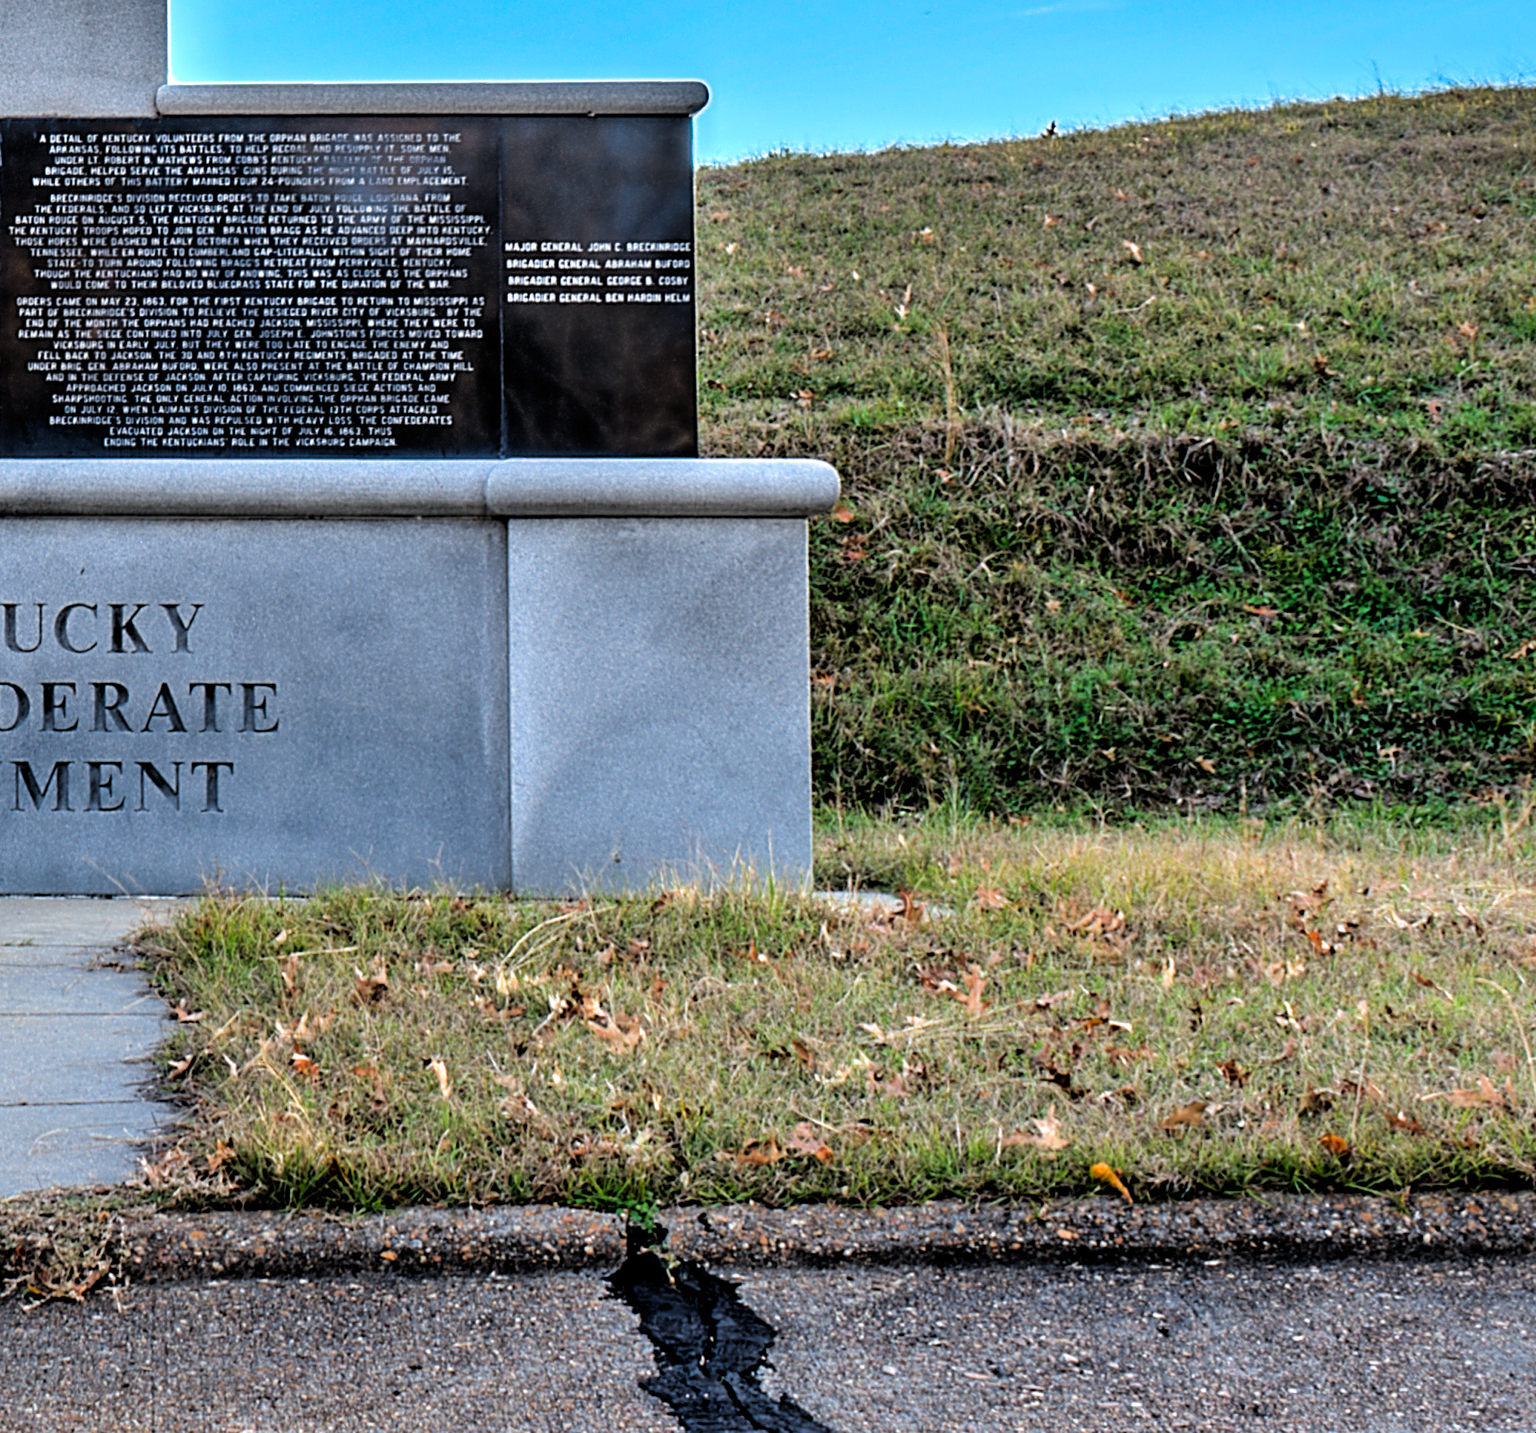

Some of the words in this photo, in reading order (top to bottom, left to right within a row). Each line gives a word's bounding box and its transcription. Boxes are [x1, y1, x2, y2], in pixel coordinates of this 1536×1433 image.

[39, 134, 47, 144] A
[49, 134, 83, 144] DETAIL
[86, 134, 99, 144] OF
[102, 134, 151, 144] KENTUCKY
[155, 134, 215, 144] VOLUNTEERS
[218, 134, 245, 144] FROM
[247, 134, 266, 144] THE
[269, 134, 307, 144] ORPHAN
[309, 134, 349, 144] BRIGADE
[353, 134, 373, 144] WAS
[377, 134, 423, 144] ASSIGNED
[426, 134, 439, 144] TO
[442, 134, 462, 144] THE
[504, 243, 538, 252] MAJOR
[540, 243, 584, 252] GENERAL
[587, 243, 612, 252] JOHN
[626, 243, 691, 252] BRECKINRIDGE
[506, 259, 556, 269] BRIGADIER
[558, 259, 602, 269] GENERAL
[604, 259, 652, 269] ABRAHAM
[654, 259, 691, 269] BUFORD
[507, 276, 558, 286] BRIGADIER
[559, 276, 604, 286] GENERAL
[606, 276, 643, 286] GEORGE
[658, 276, 689, 286] COSBY
[16, 297, 52, 306] ORDERS
[56, 297, 81, 306] CAME
[85, 297, 98, 306] ON
[100, 297, 121, 306] MAY
[170, 297, 189, 306] FOR
[192, 297, 210, 306] THE
[214, 297, 241, 306] FIRST
[244, 297, 293, 306] KENTUCKY
[296, 297, 336, 306] BRIGADE
[341, 297, 354, 306] TO
[356, 297, 394, 306] RETURN
[397, 297, 410, 306] TO
[413, 297, 468, 306] MISSISSIPPI
[472, 297, 485, 306] AS
[507, 293, 556, 303] BRIGADIER
[558, 293, 602, 303] GENERAL
[605, 293, 625, 303] BEN
[627, 293, 662, 303] HARDIN
[664, 293, 691, 303] HELM
[103, 438, 137, 447] ENDING
[140, 438, 158, 447] THE
[231, 438, 255, 447] ROLE
[258, 438, 269, 447] IN
[272, 438, 290, 447] THE
[295, 438, 346, 447] VICKSBURG
